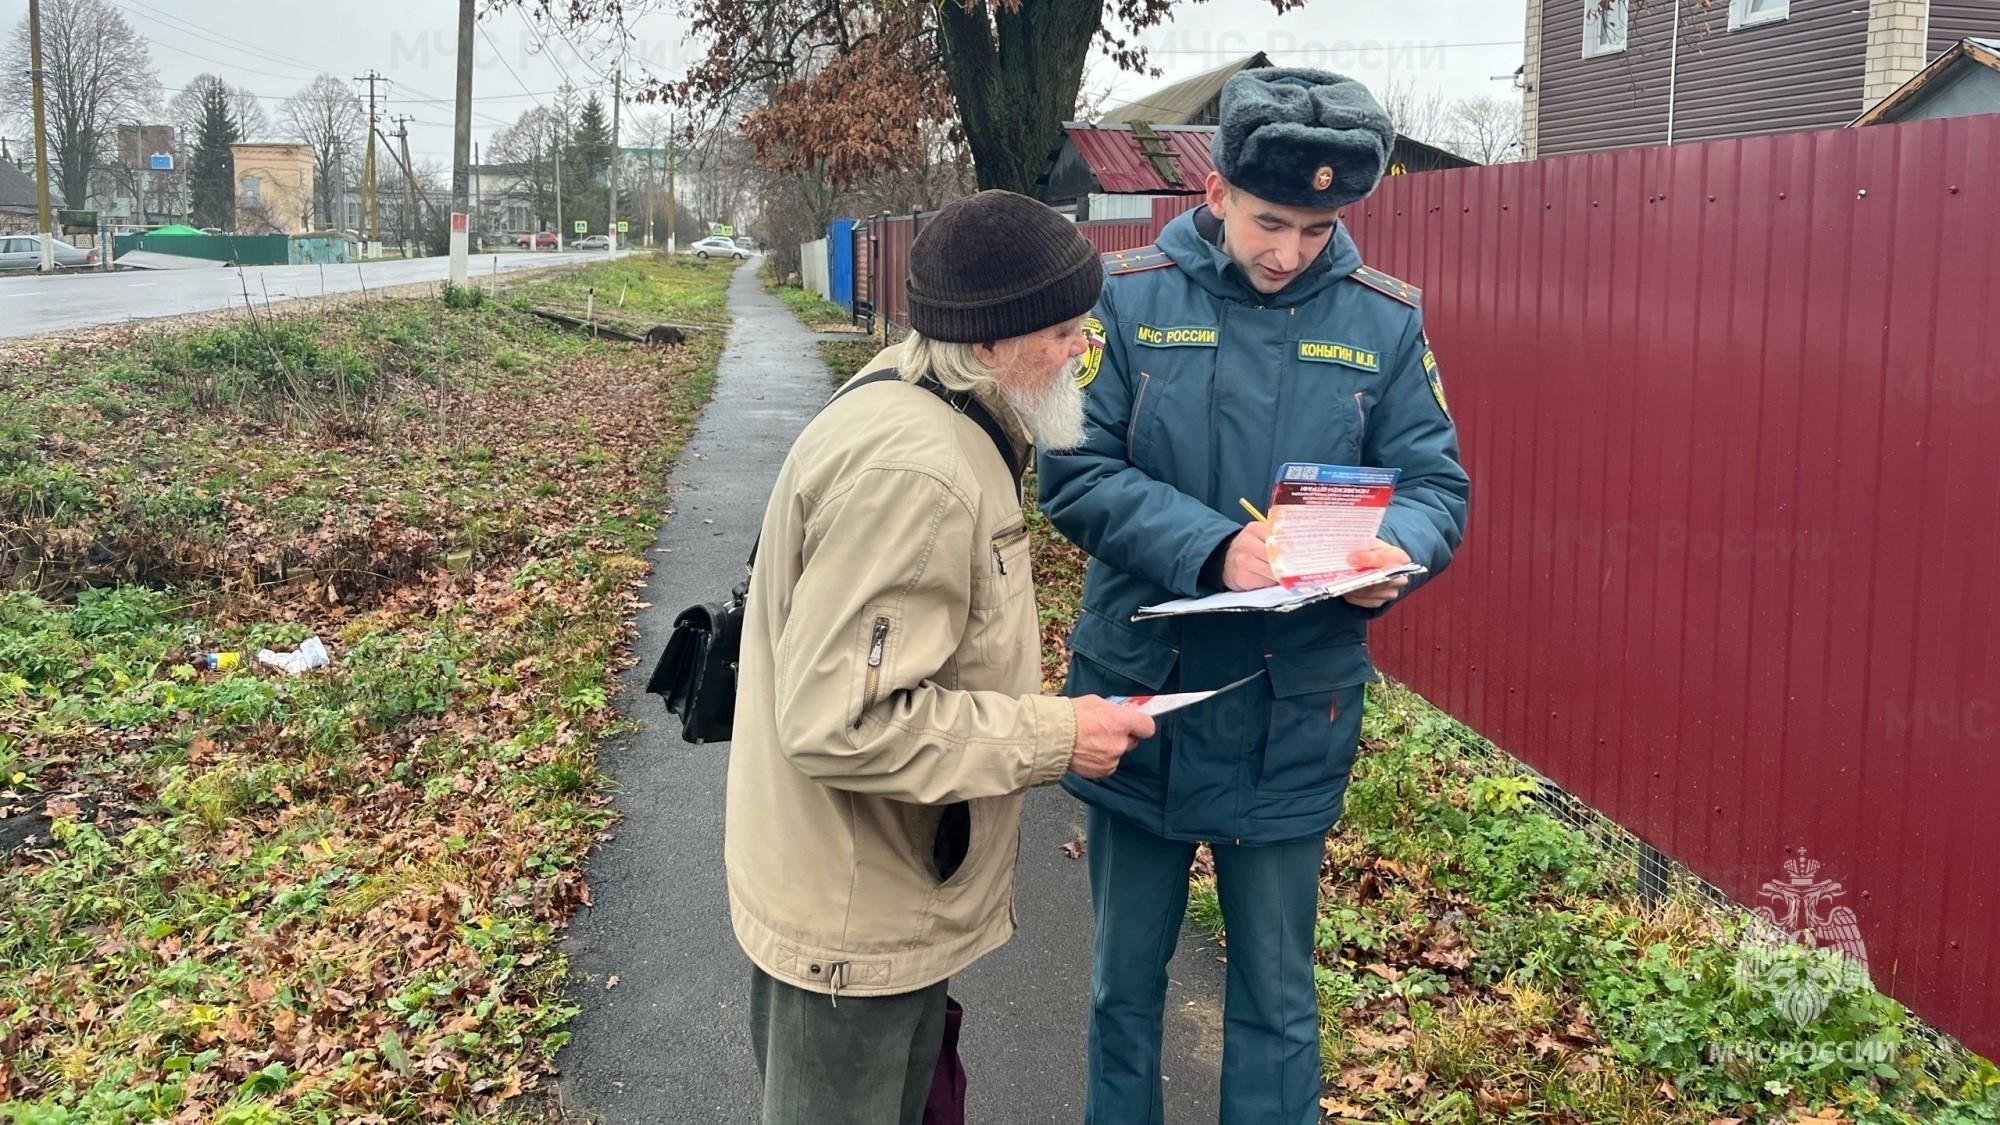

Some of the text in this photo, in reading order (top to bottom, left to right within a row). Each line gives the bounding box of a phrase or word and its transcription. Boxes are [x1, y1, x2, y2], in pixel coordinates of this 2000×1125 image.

[1137, 326, 1216, 344] МЧС РОССИИ
[1301, 343, 1353, 362] КОНЫГИН
